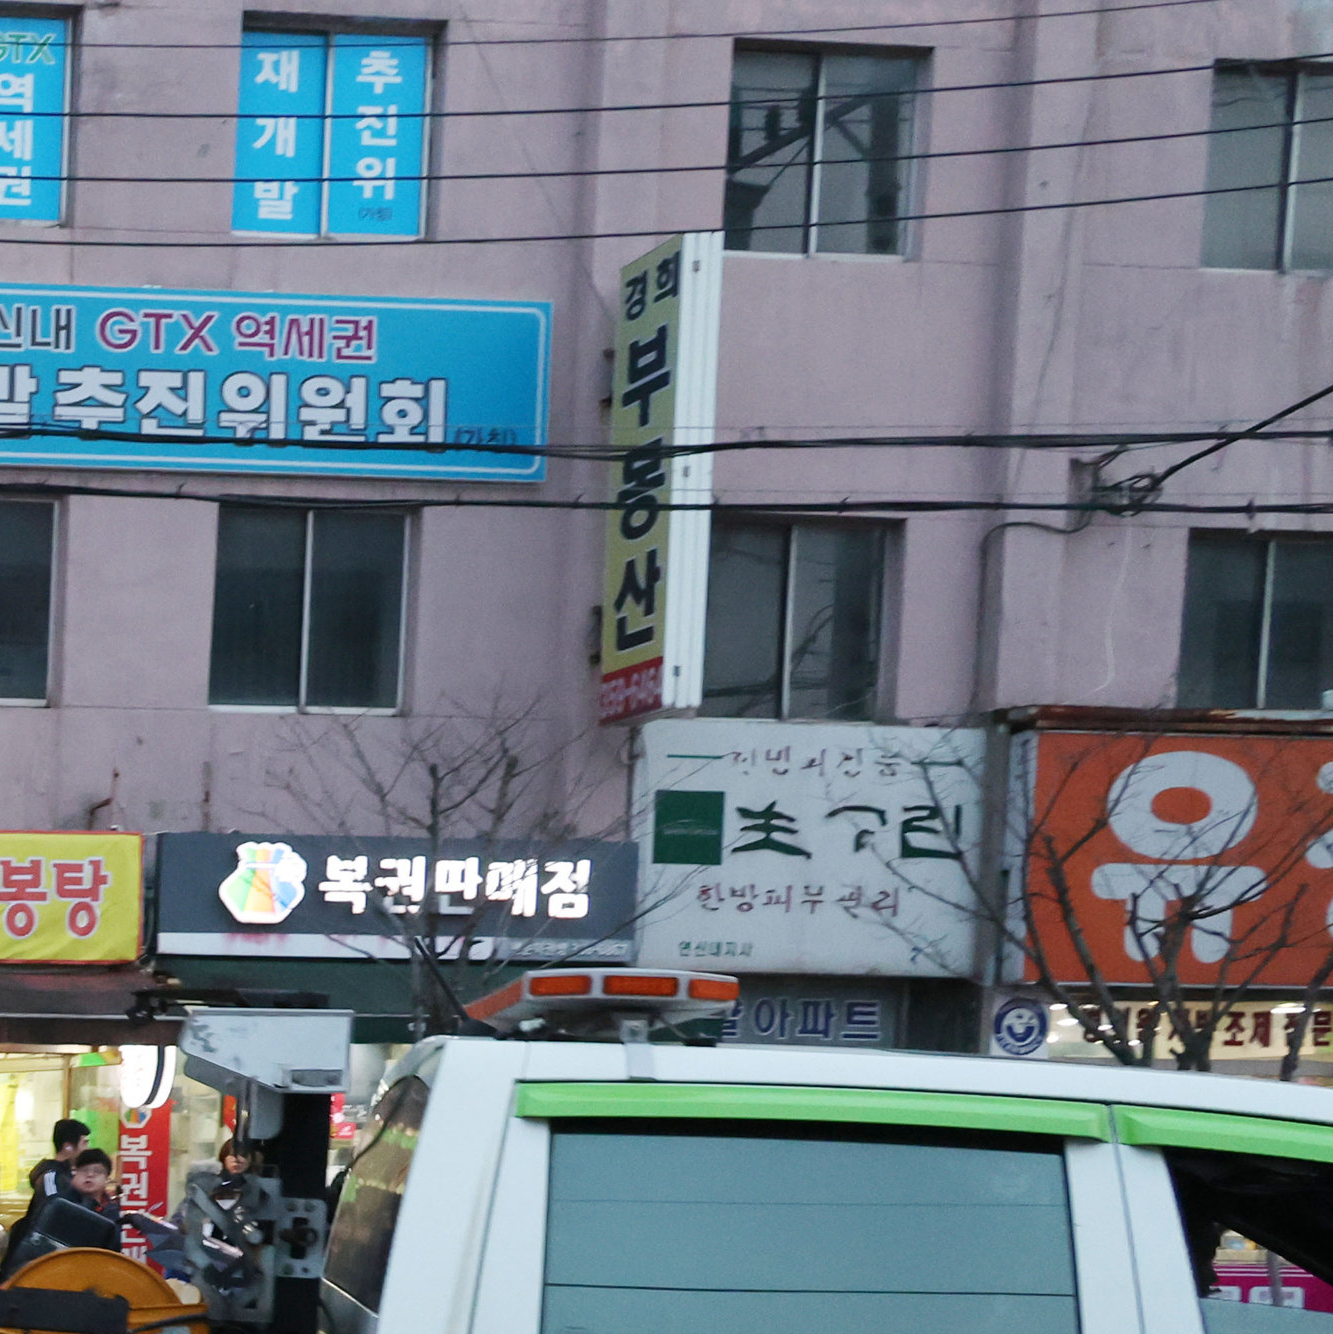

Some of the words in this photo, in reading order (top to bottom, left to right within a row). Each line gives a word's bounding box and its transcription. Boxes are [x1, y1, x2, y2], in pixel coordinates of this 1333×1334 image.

[253, 50, 300, 220] 재개발
[354, 51, 403, 200] 추진위
[52, 366, 449, 450] 추진위원회
[97, 309, 221, 355] GTX
[233, 316, 379, 363] 역세권
[614, 322, 672, 651] 부동산
